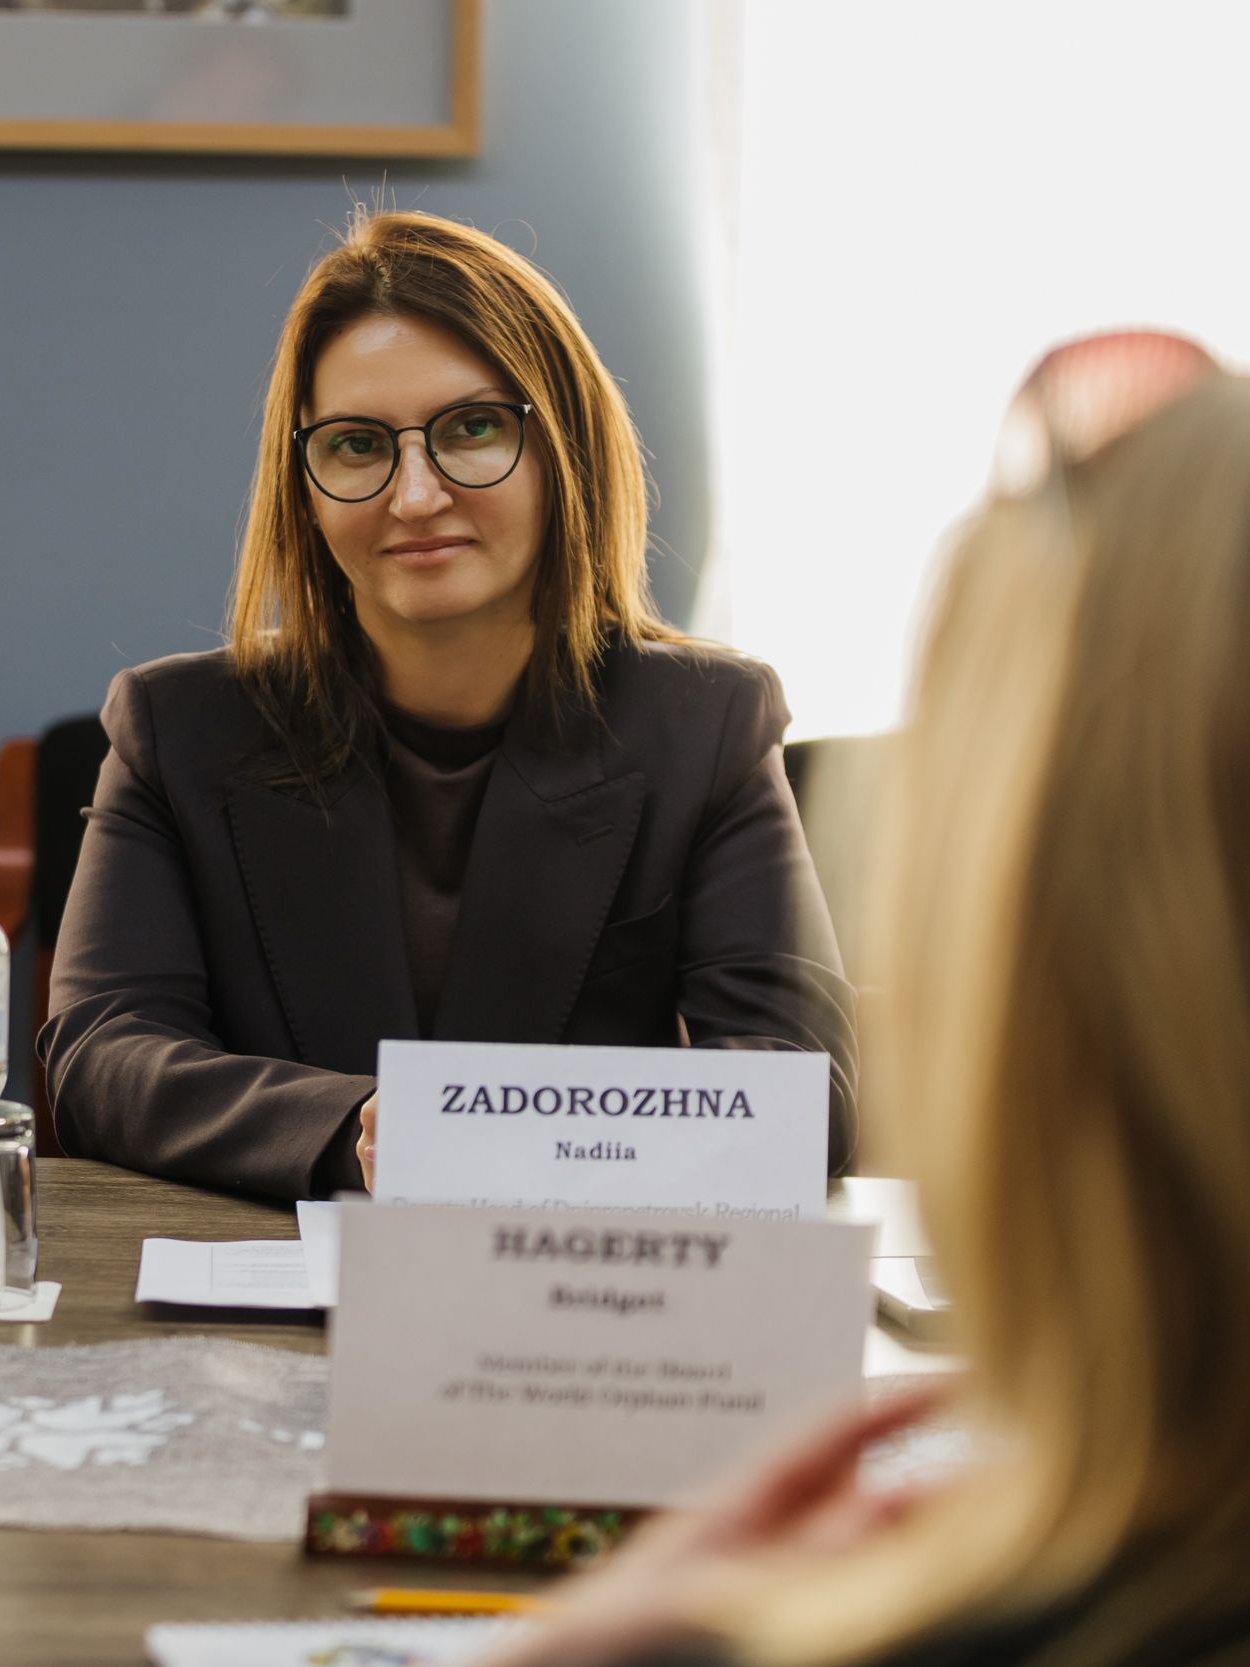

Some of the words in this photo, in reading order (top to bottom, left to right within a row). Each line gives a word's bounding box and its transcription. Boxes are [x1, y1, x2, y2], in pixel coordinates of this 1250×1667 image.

[439, 1084, 756, 1119] ZADOROZHNA
[554, 1141, 637, 1161] Nadiia
[492, 1225, 731, 1268] HAGERTY
